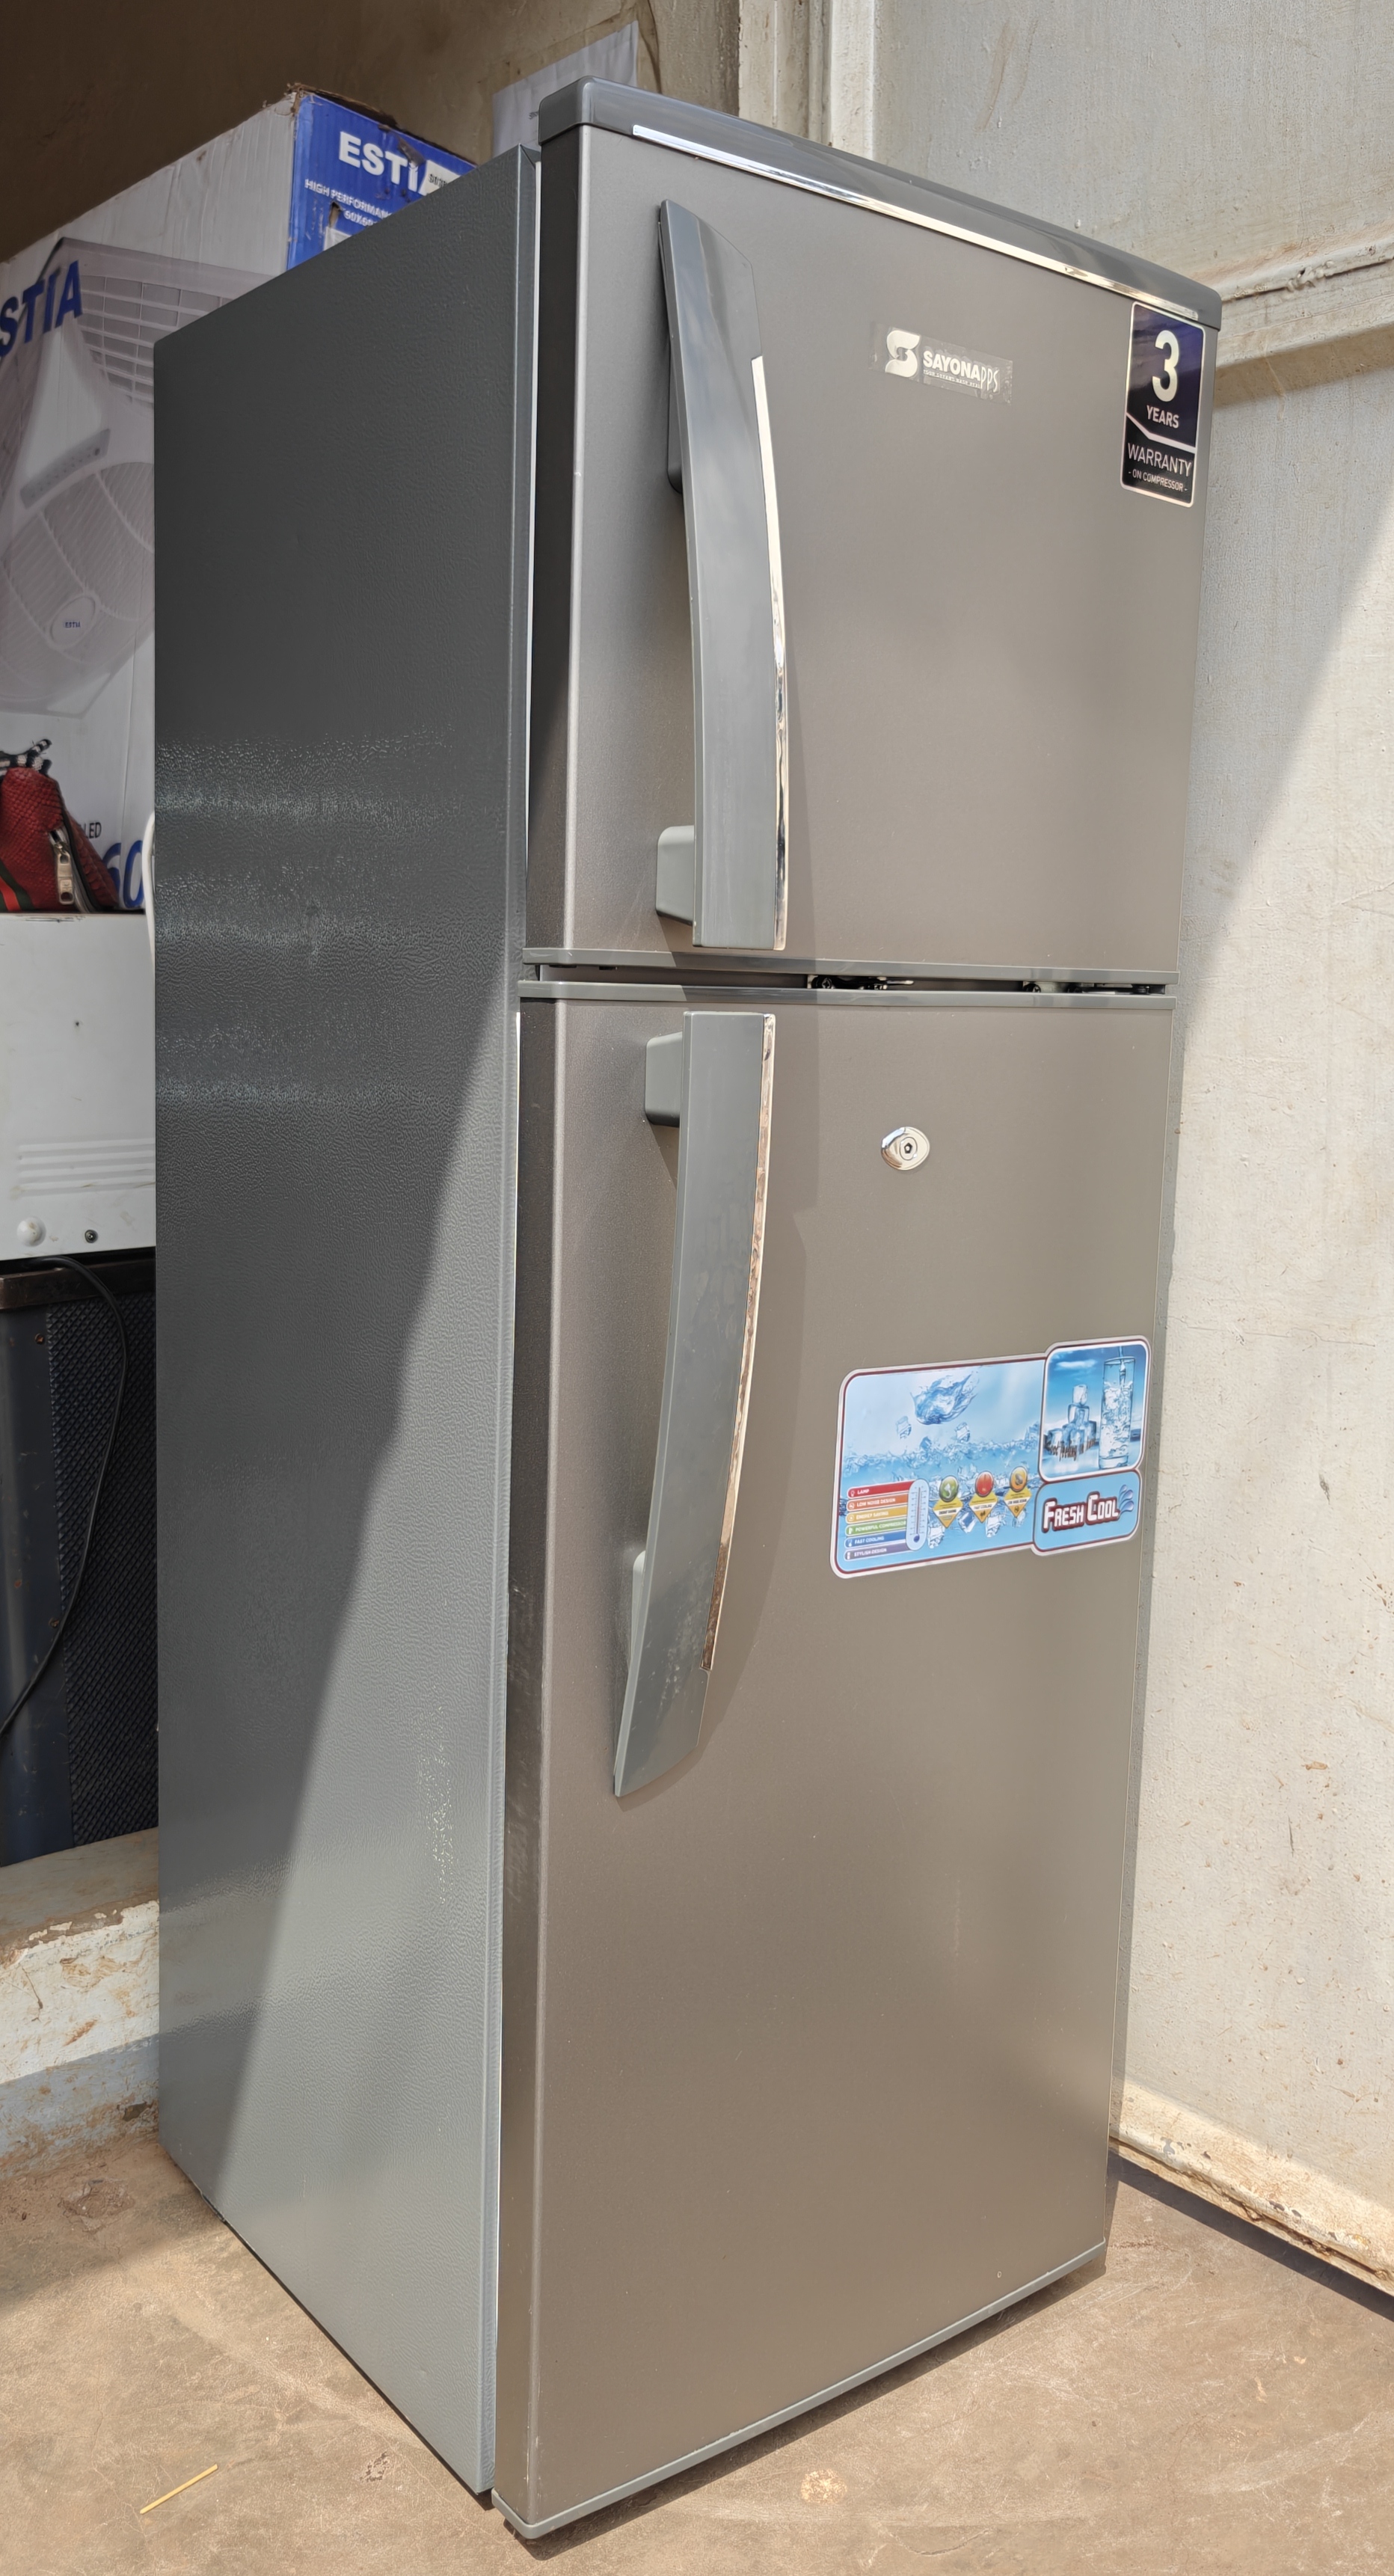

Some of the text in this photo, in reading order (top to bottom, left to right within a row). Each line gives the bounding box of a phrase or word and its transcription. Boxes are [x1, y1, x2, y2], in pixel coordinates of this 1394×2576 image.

[339, 131, 429, 196] ESTI
[304, 179, 330, 197] HIGH
[1152, 330, 1179, 402] 3
[1146, 405, 1179, 429] YEARS
[1128, 442, 1192, 477] WARRANTY
[1132, 468, 1184, 492] ON COMPRESSOR
[1043, 1494, 1120, 1530] FRESH COOL
